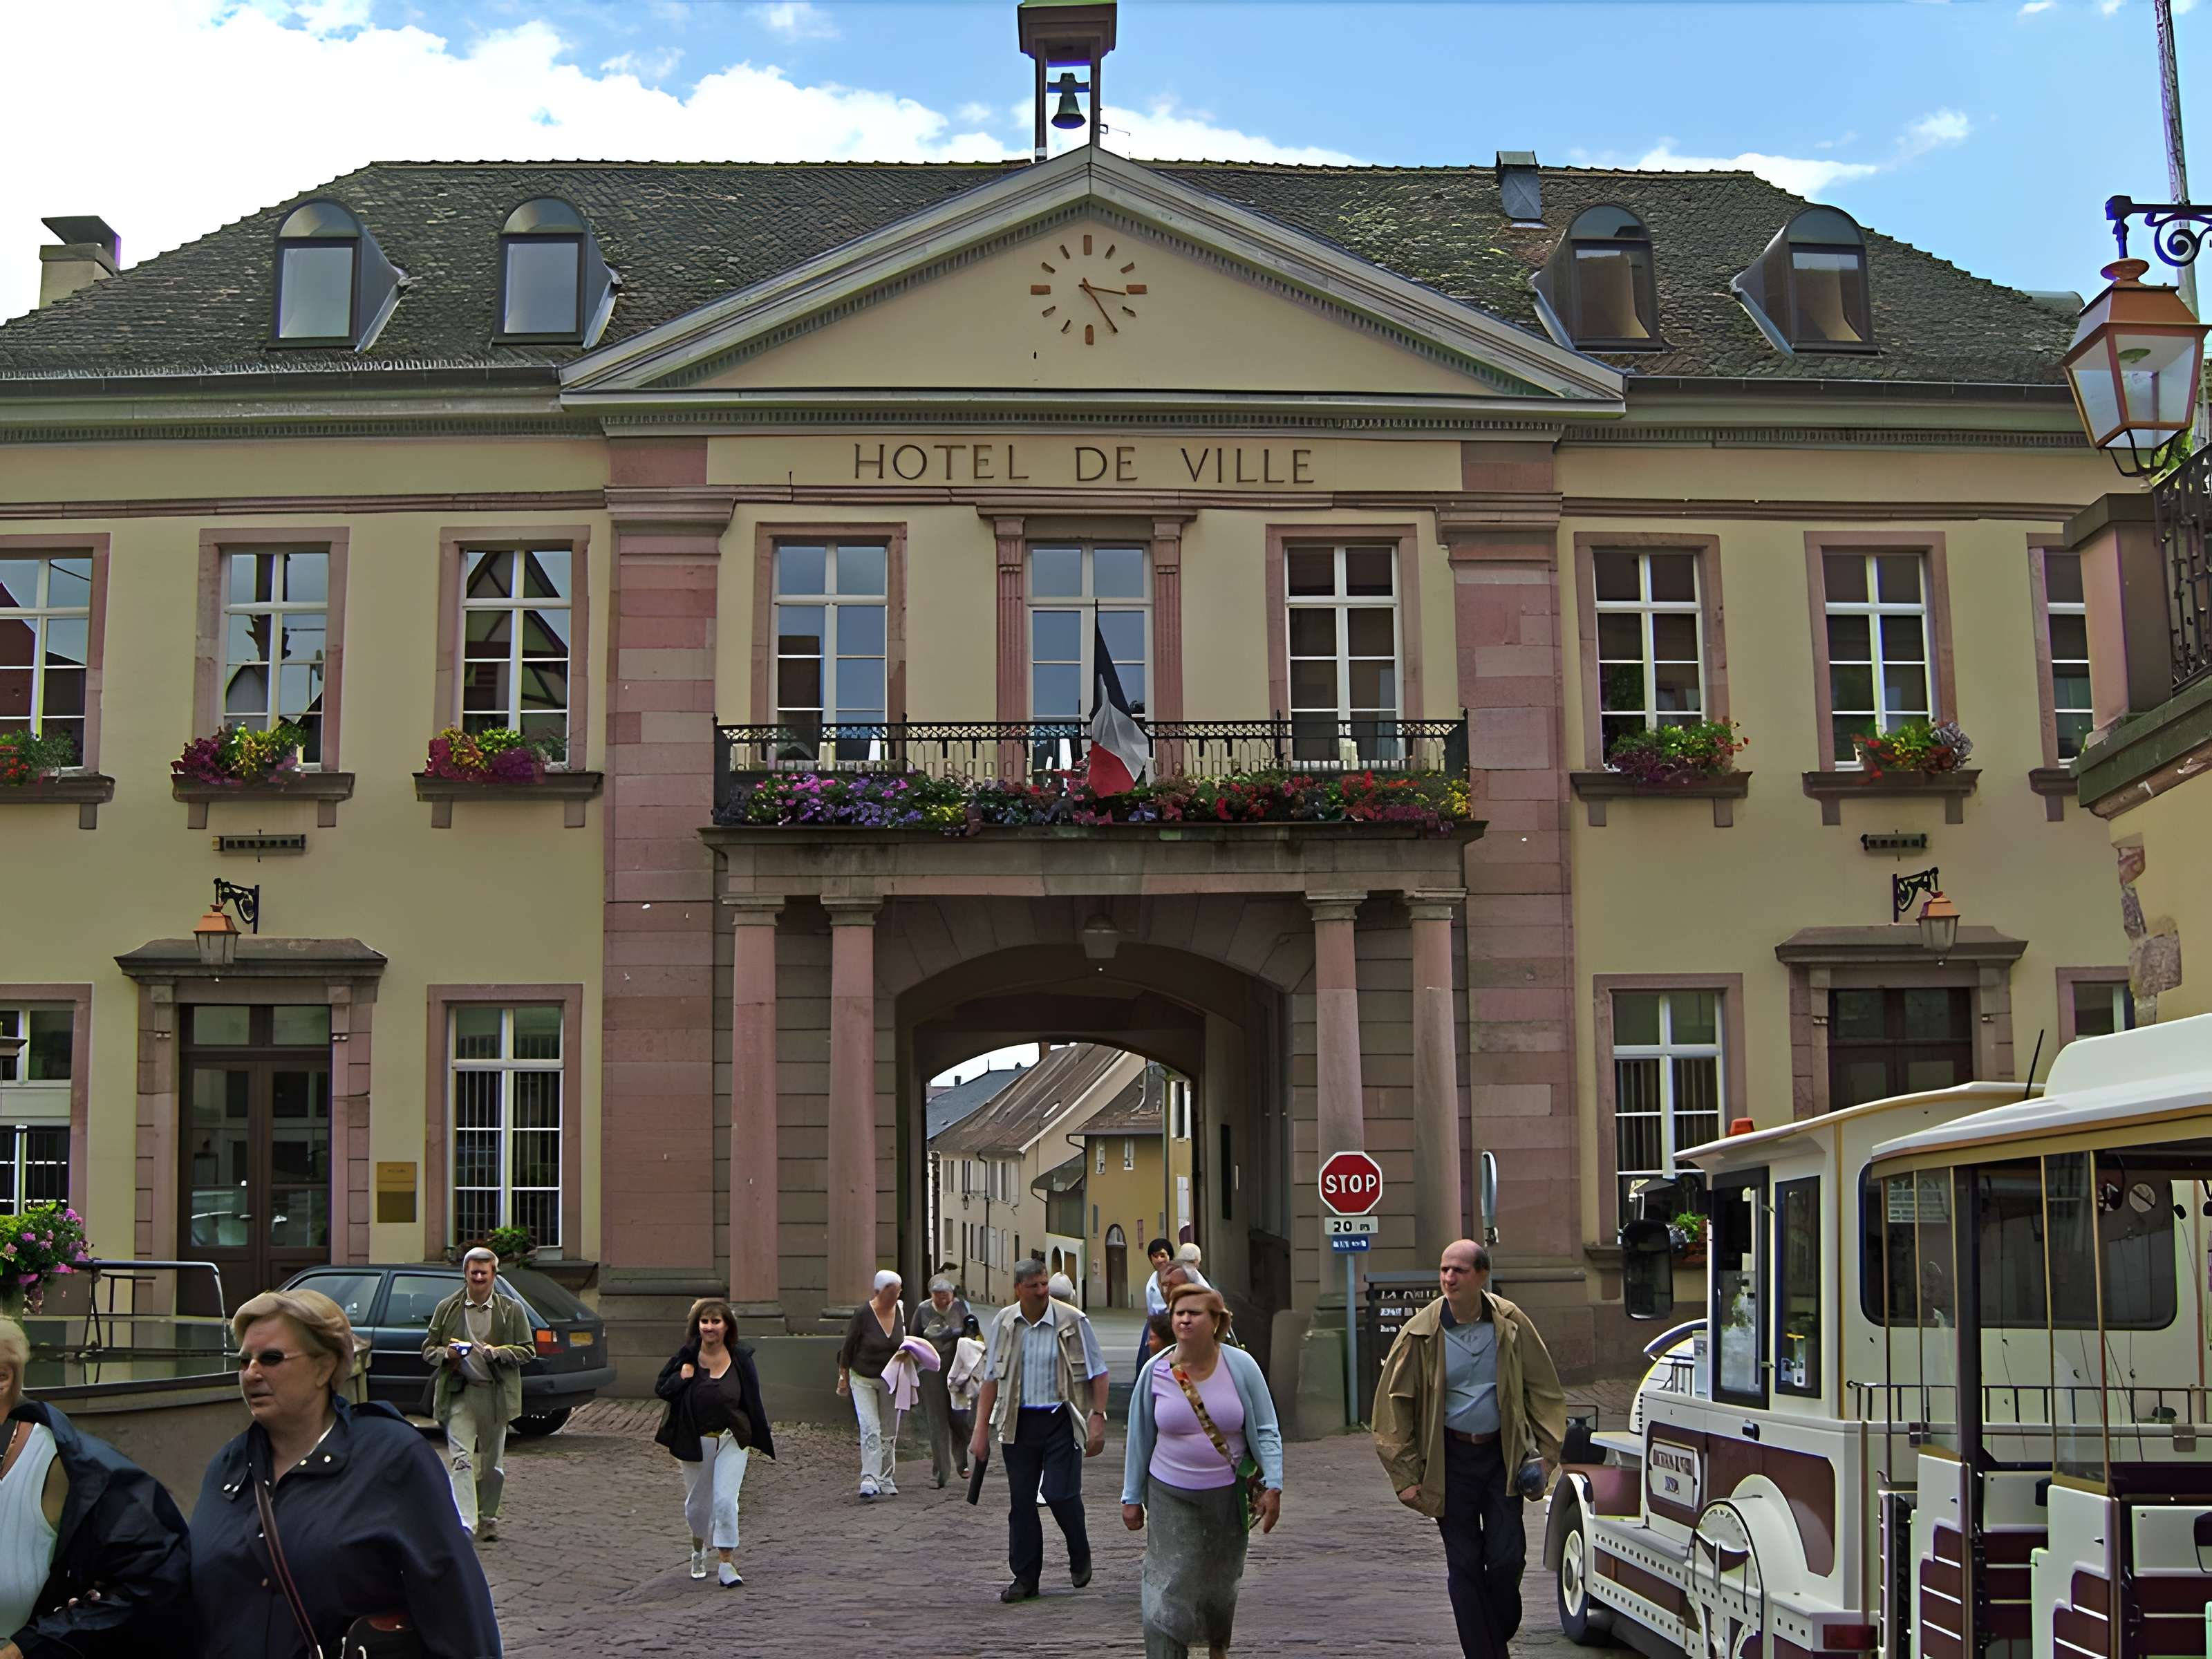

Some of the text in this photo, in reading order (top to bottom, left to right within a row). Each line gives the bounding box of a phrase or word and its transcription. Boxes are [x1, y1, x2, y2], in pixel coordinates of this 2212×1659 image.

[854, 444, 1314, 483] HOTEL DE VILLE
[1324, 1174, 1377, 1194] STOP
[1333, 1221, 1352, 1232] 20
